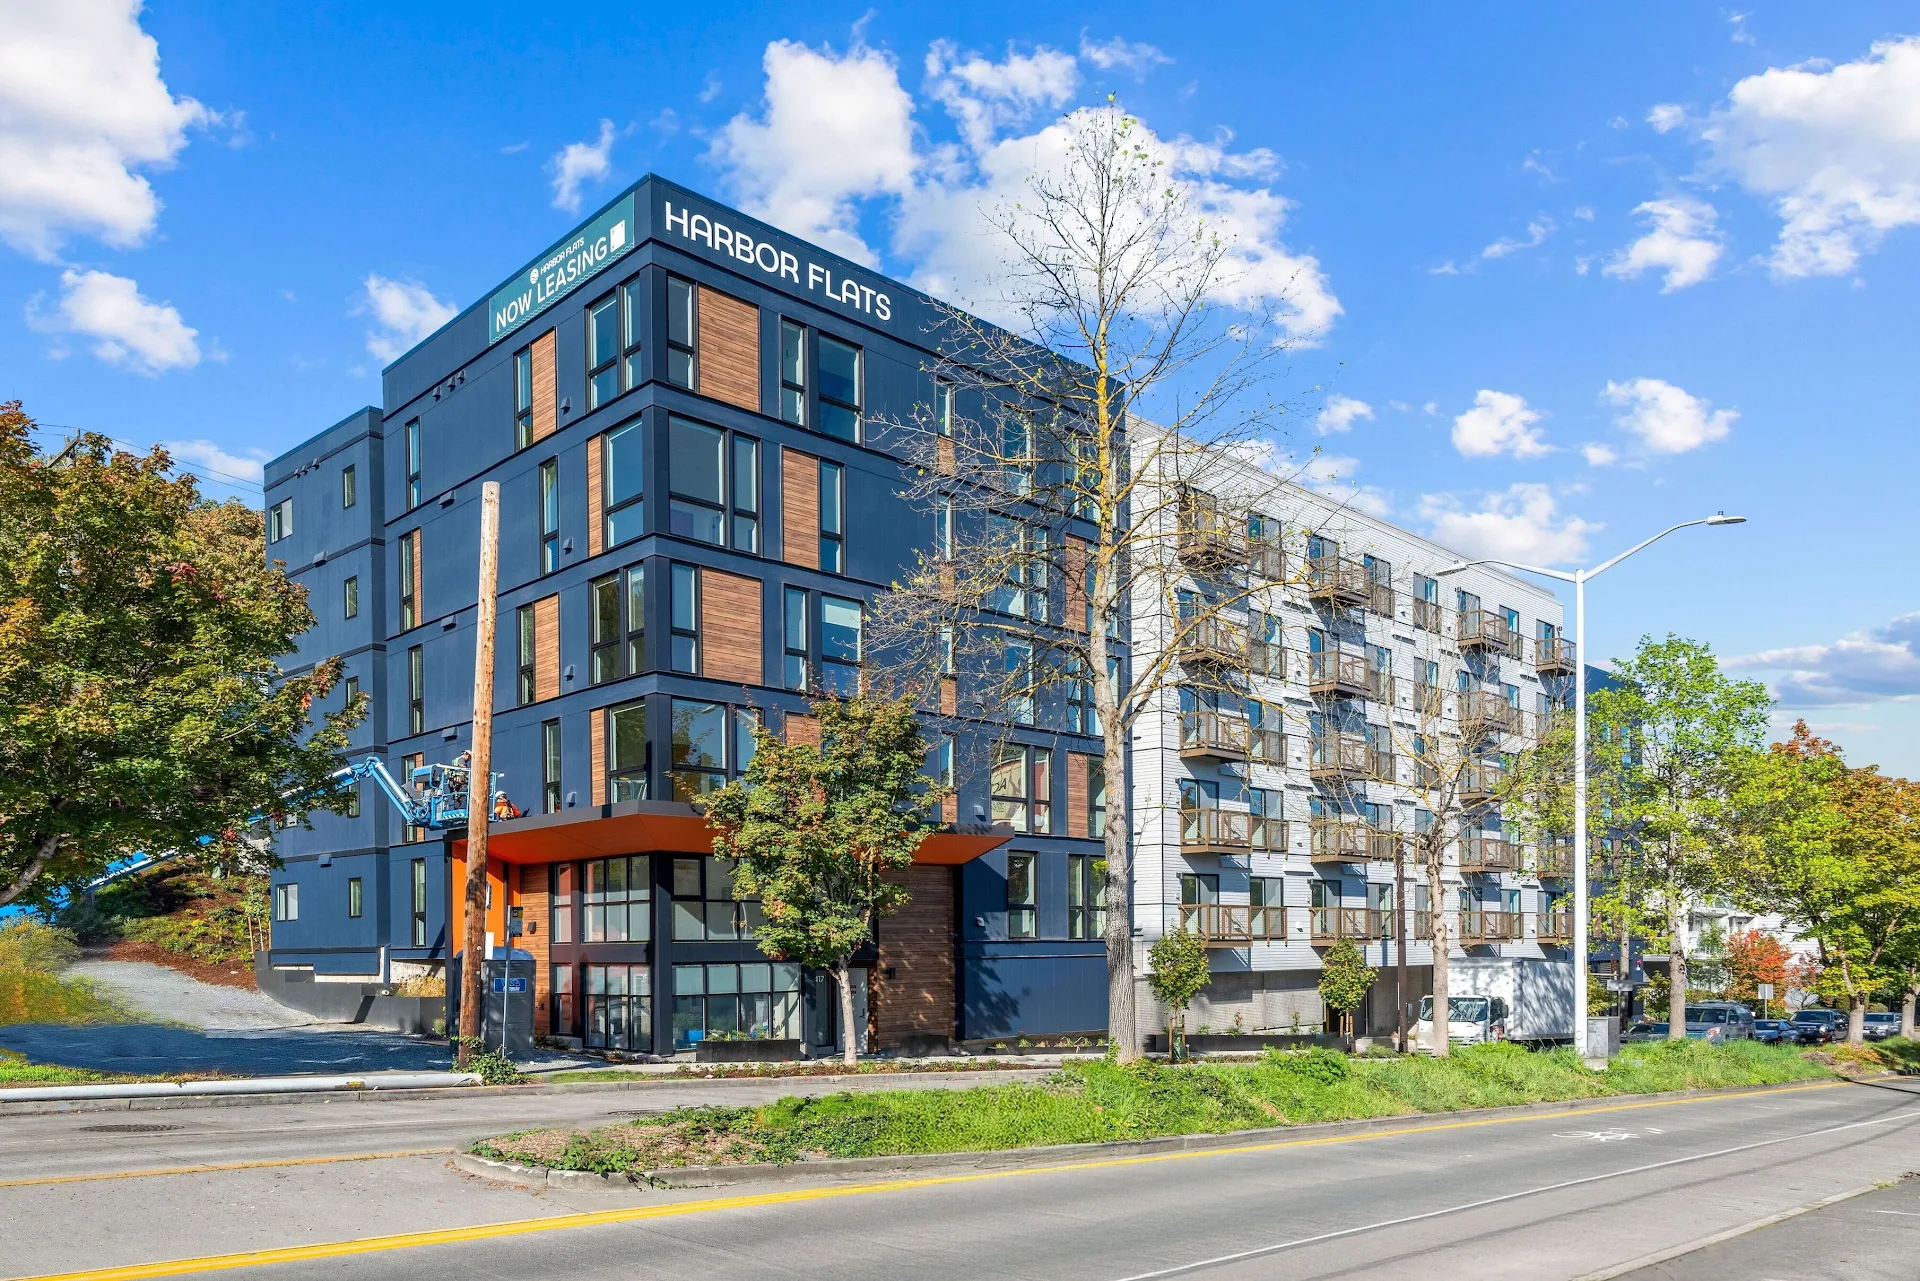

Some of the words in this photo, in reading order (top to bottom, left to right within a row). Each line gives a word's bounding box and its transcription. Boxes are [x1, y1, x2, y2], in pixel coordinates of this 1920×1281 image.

[496, 289, 532, 332] NOW
[537, 236, 607, 303] LEASING
[540, 251, 565, 275] HARBOR
[565, 237, 584, 257] FLATS
[665, 201, 799, 284] HARBOR
[808, 262, 891, 321] FLATS
